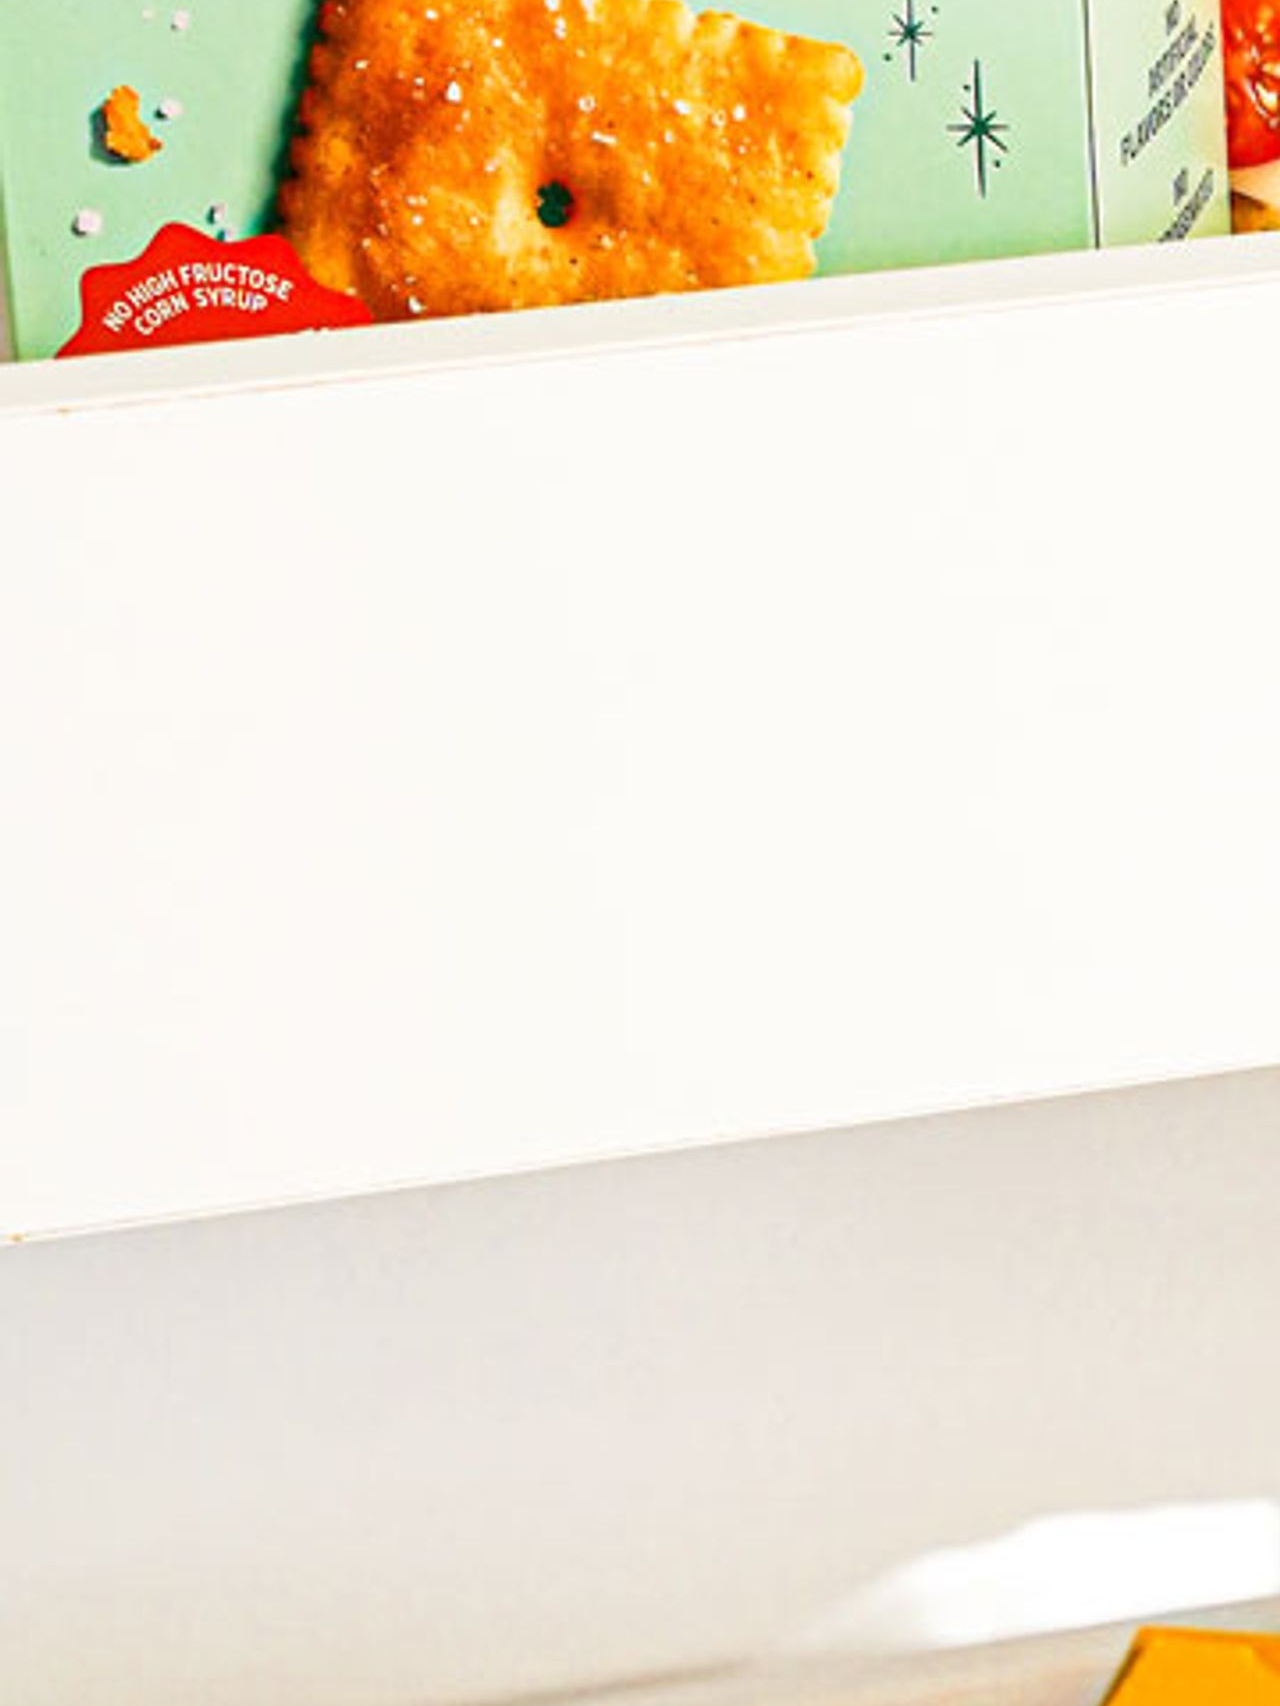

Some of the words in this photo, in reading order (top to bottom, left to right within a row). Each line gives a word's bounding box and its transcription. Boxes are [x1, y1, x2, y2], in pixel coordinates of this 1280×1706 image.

[103, 301, 132, 332] NO
[125, 267, 179, 307] HIGH
[179, 263, 293, 301] FRUCTOSE
[134, 293, 189, 336] CORN
[193, 287, 268, 312] SYRUP
